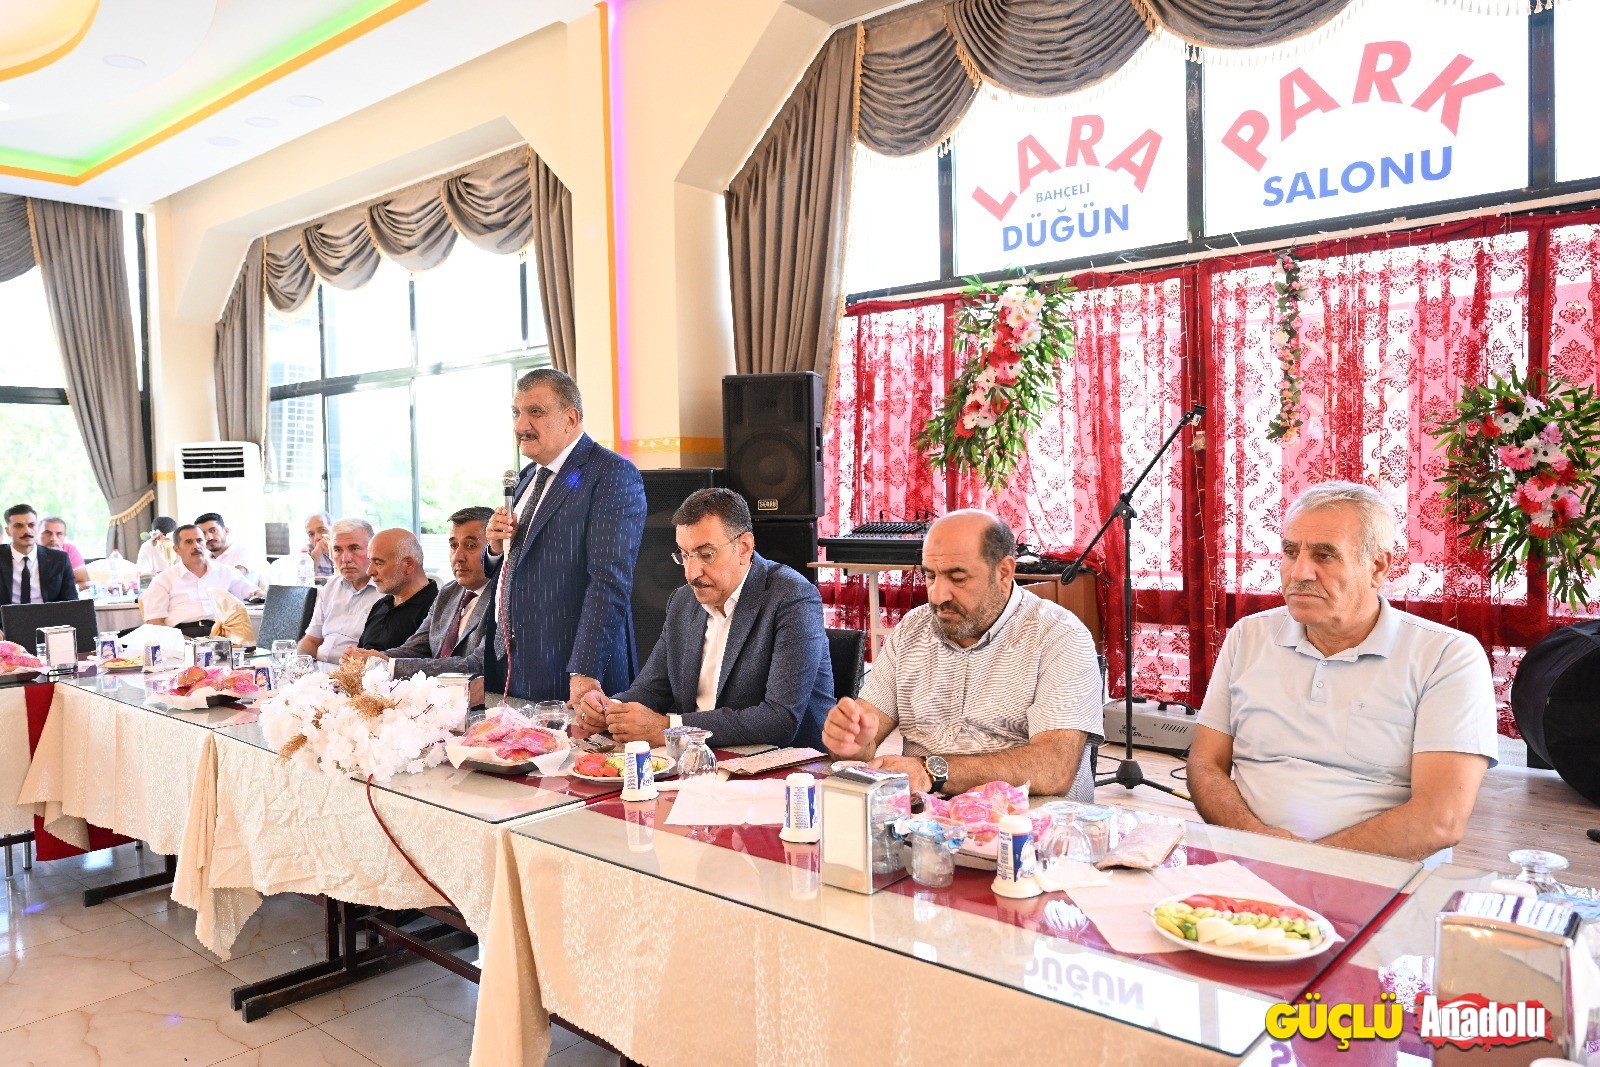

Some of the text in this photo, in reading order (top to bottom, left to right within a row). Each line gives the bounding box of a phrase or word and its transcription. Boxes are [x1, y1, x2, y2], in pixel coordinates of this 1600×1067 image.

[971, 40, 1506, 221] LARA PARK
[1003, 146, 1453, 252] DÜĞÜN SALONU
[1036, 181, 1090, 203] BAHÇELİ
